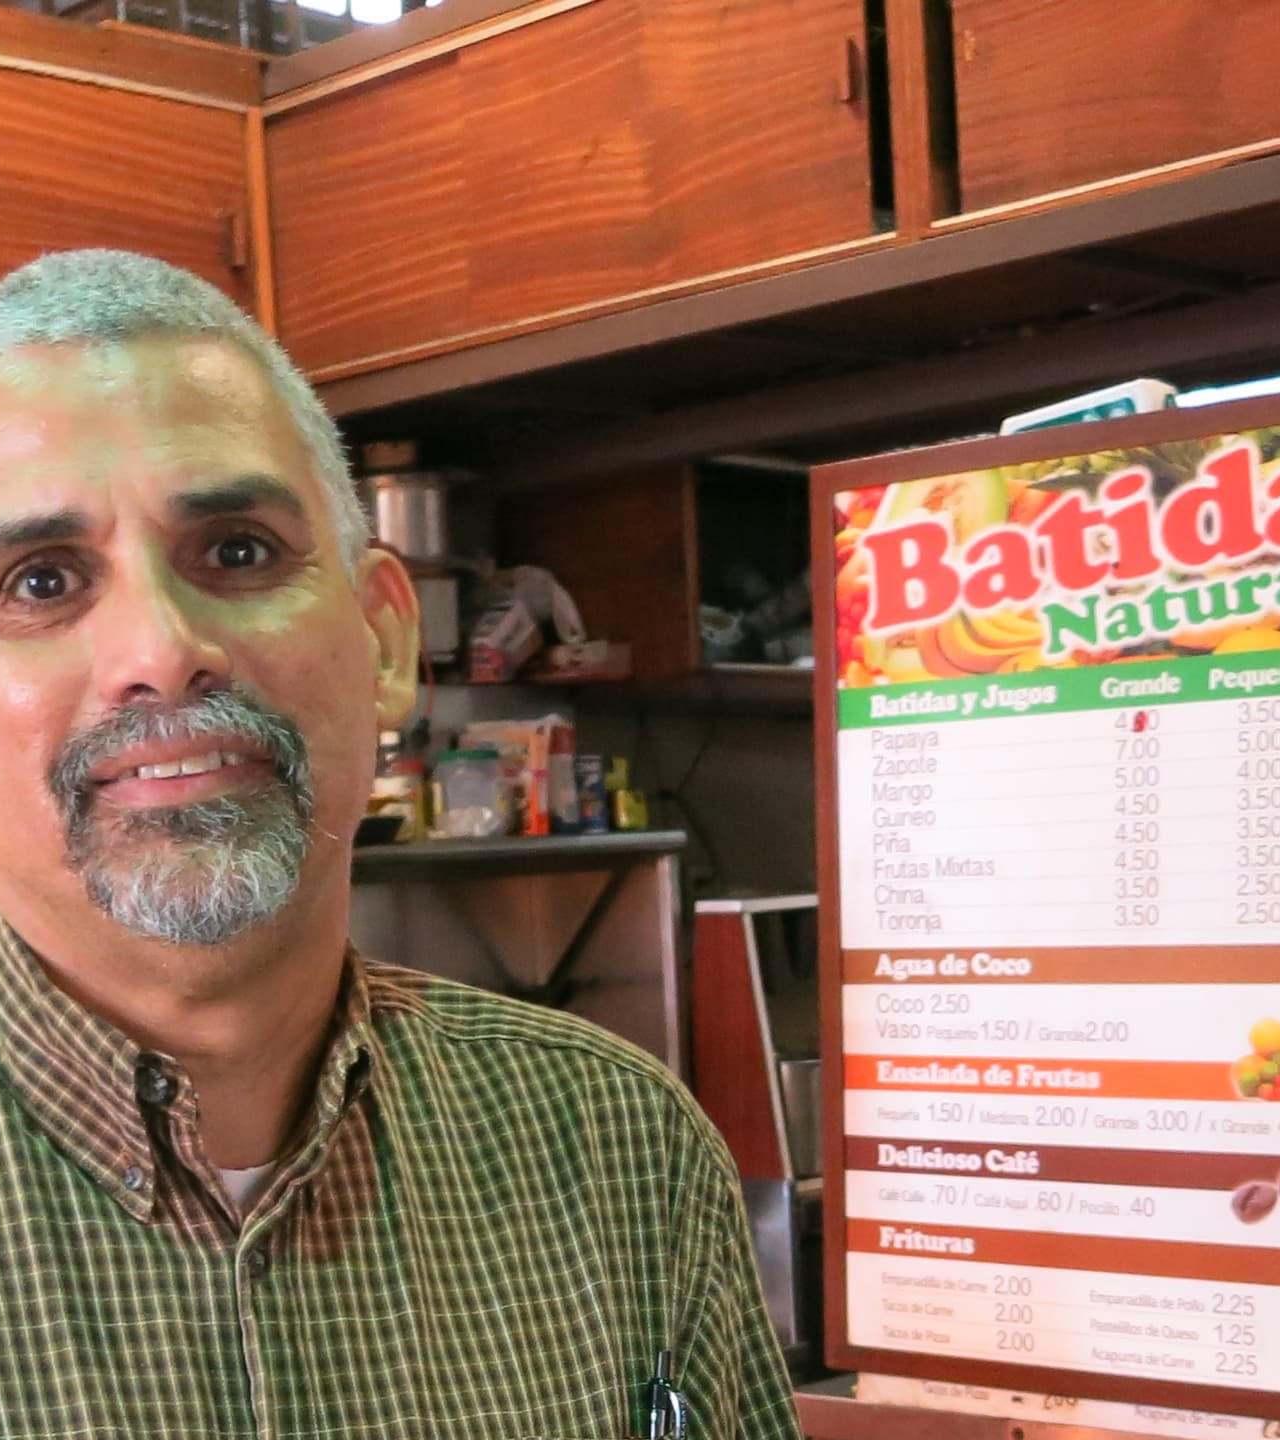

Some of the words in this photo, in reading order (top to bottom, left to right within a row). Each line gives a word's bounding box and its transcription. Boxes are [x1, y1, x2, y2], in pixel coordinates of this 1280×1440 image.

[1100, 672, 1181, 699] Grande
[870, 692, 957, 718] Batidas
[961, 691, 977, 714] y
[981, 684, 1057, 711] Jugos
[871, 728, 940, 754] Papaya
[1115, 738, 1160, 761] 7.00
[872, 755, 937, 781] Zapote
[1114, 766, 1160, 789] 5.00
[872, 782, 933, 806] Mango
[1114, 793, 1160, 816] 4.50
[872, 807, 937, 829] Guineo
[872, 832, 911, 854] Piña
[1114, 821, 1160, 844] 4.50
[873, 858, 930, 880] Frutas
[1114, 849, 1160, 872] 4.50
[874, 884, 925, 906] China
[1114, 877, 1160, 899] 3.50
[876, 909, 942, 934] Toronja
[1114, 905, 1160, 928] 3.50
[875, 953, 936, 981] Agua
[939, 954, 968, 976] de
[971, 952, 1032, 977] Coco
[876, 993, 925, 1015] Coco
[930, 993, 970, 1015] 2.50
[875, 1019, 921, 1040] Vaso
[981, 1020, 1018, 1042] 1.50
[1086, 1021, 1129, 1042] 2.00
[876, 1060, 980, 1086] Ensalada
[983, 1063, 1013, 1086] de
[1016, 1064, 1101, 1089] Frutas
[927, 1103, 963, 1124] 1.50
[1035, 1106, 1076, 1127] 2.00
[1146, 1109, 1189, 1132] 3.00
[878, 1144, 982, 1171] Delicioso
[985, 1149, 1040, 1174] Café
[879, 1226, 976, 1254] Frituras
[993, 1275, 1033, 1297] 2.00
[995, 1302, 1034, 1325] 2.00
[1212, 1293, 1256, 1316] 2.25
[996, 1329, 1035, 1352] 2.00
[1213, 1323, 1256, 1346] 1.25
[1215, 1351, 1259, 1375] 2.25
